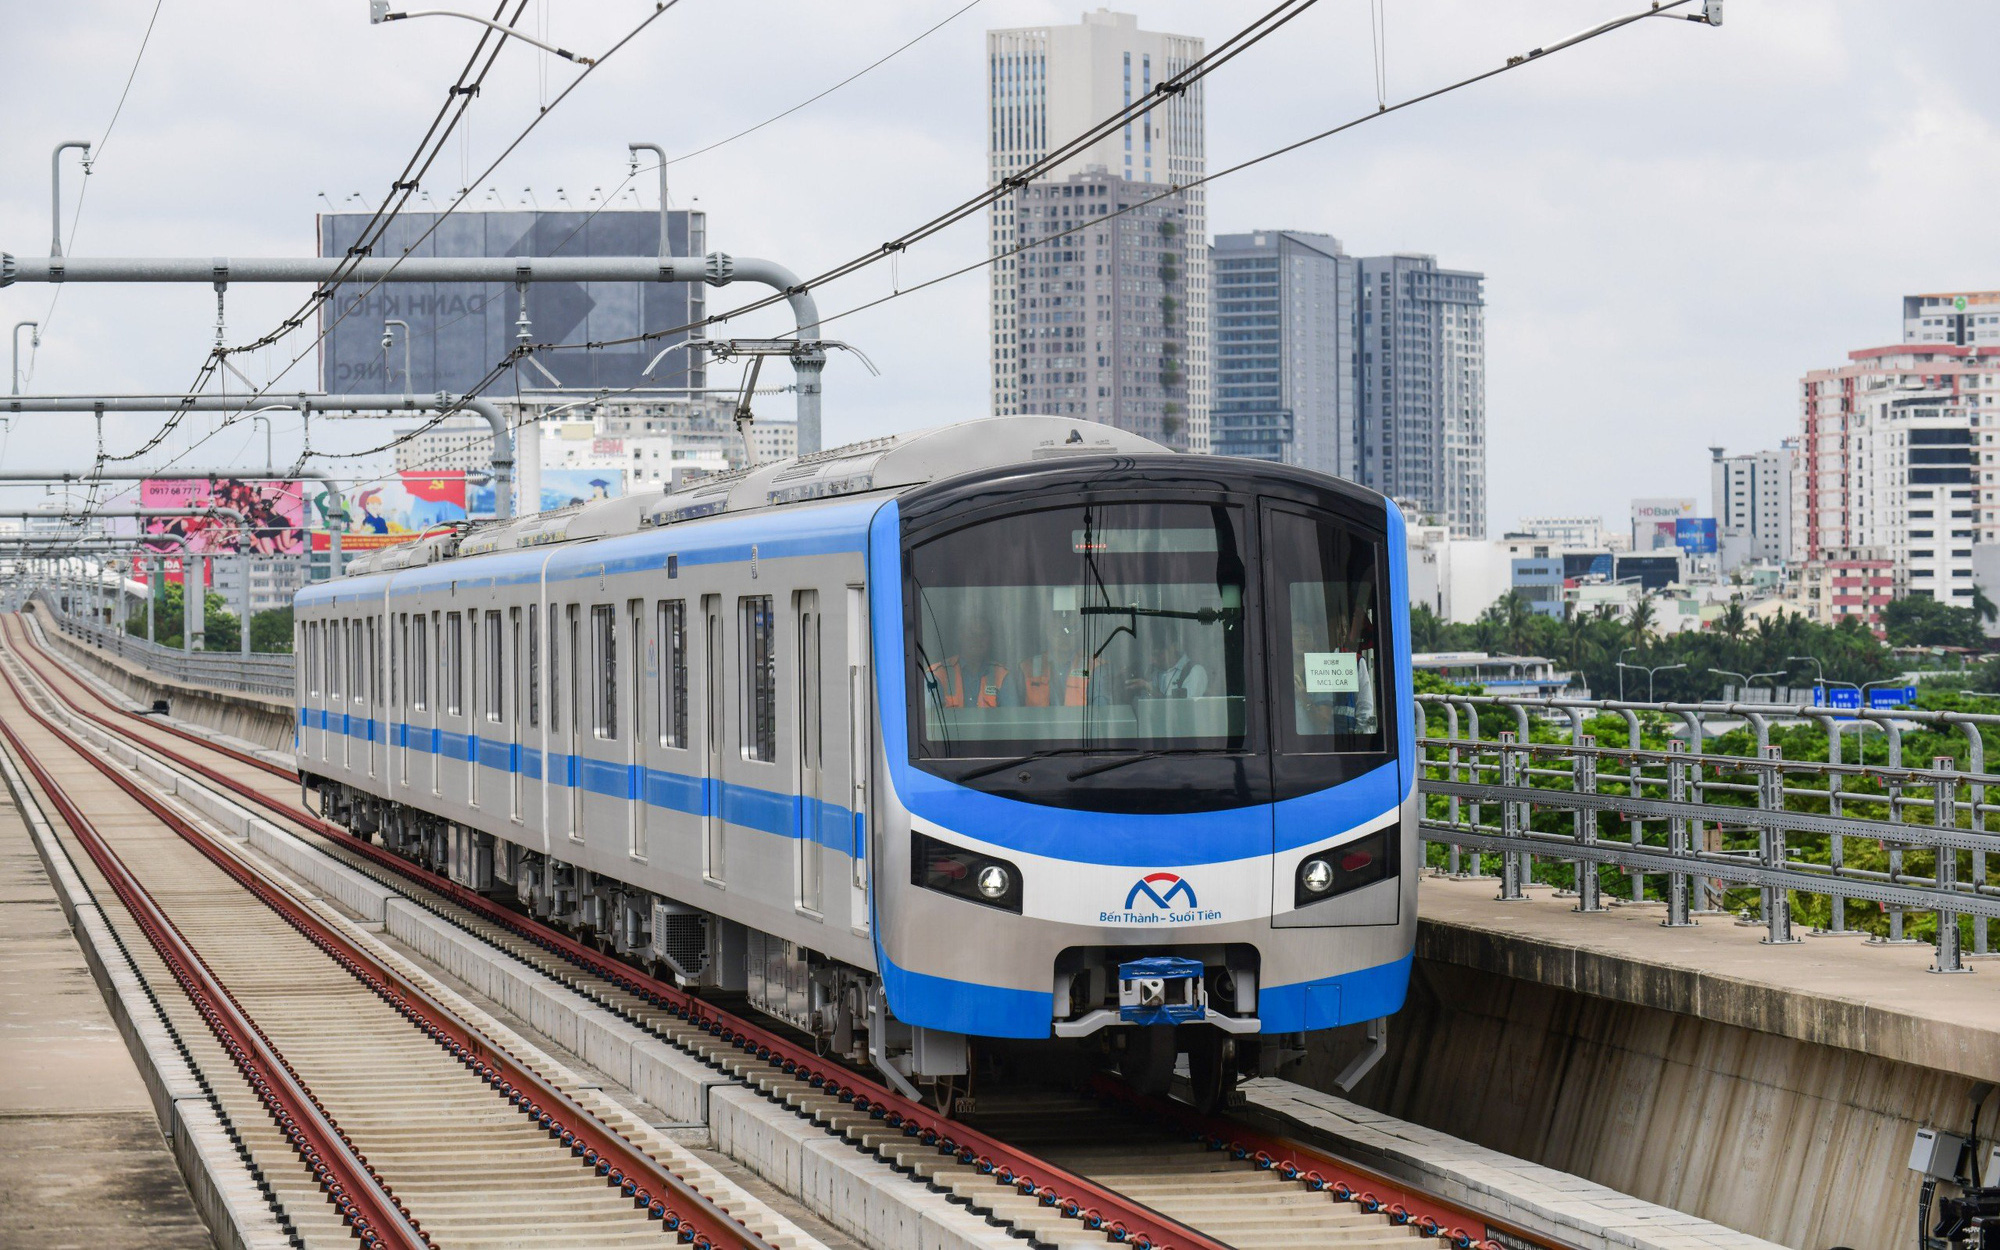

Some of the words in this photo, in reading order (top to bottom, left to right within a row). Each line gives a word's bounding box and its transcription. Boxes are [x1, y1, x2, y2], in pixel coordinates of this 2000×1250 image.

[149, 487, 169, 495] 0917
[183, 487, 201, 495] 777
[1638, 507, 1680, 517] HDBank
[1099, 910, 1121, 922] Bến
[1123, 912, 1159, 923] Thành
[1169, 910, 1195, 922] Suối
[1197, 909, 1222, 921] Tiên
